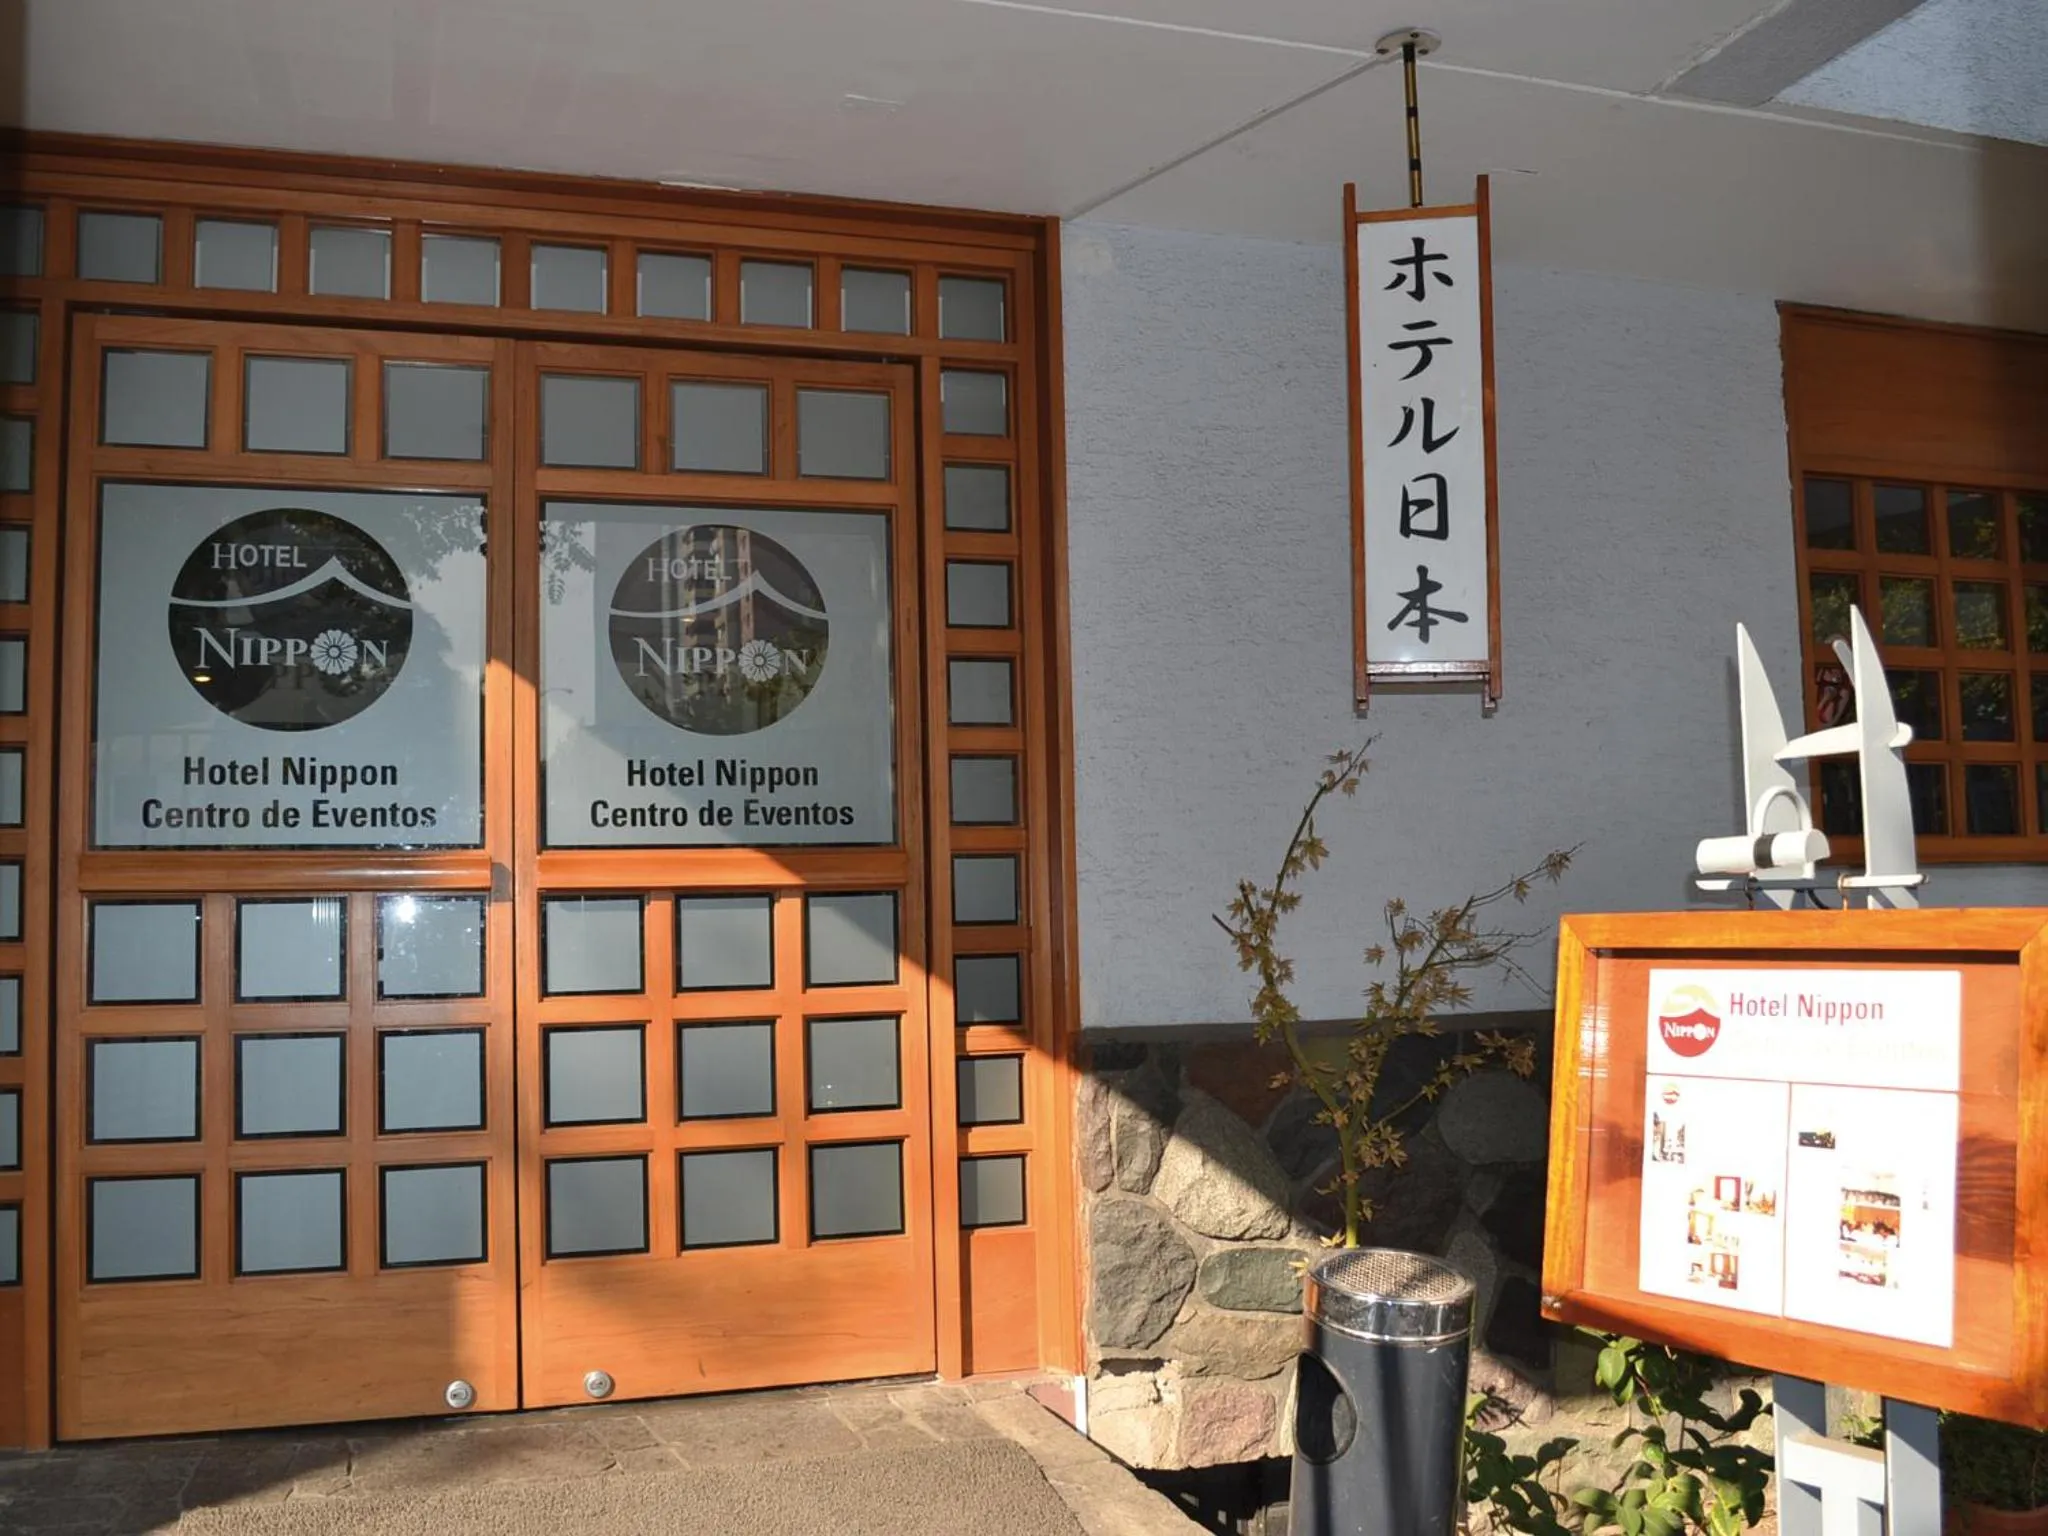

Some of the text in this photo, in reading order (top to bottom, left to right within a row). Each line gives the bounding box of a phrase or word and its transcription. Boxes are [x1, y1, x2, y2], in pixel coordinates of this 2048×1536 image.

[1383, 237, 1469, 644] ホテル日本
[211, 543, 307, 569] HOTEL
[648, 557, 732, 582] HOTEL
[183, 757, 398, 793] Hotel Nippon
[627, 759, 819, 793] Hotel Nippon
[141, 799, 437, 829] Centro de Eventos
[590, 799, 854, 827] Centro de Eventos
[1730, 993, 1884, 1025] Hotel Nippon
